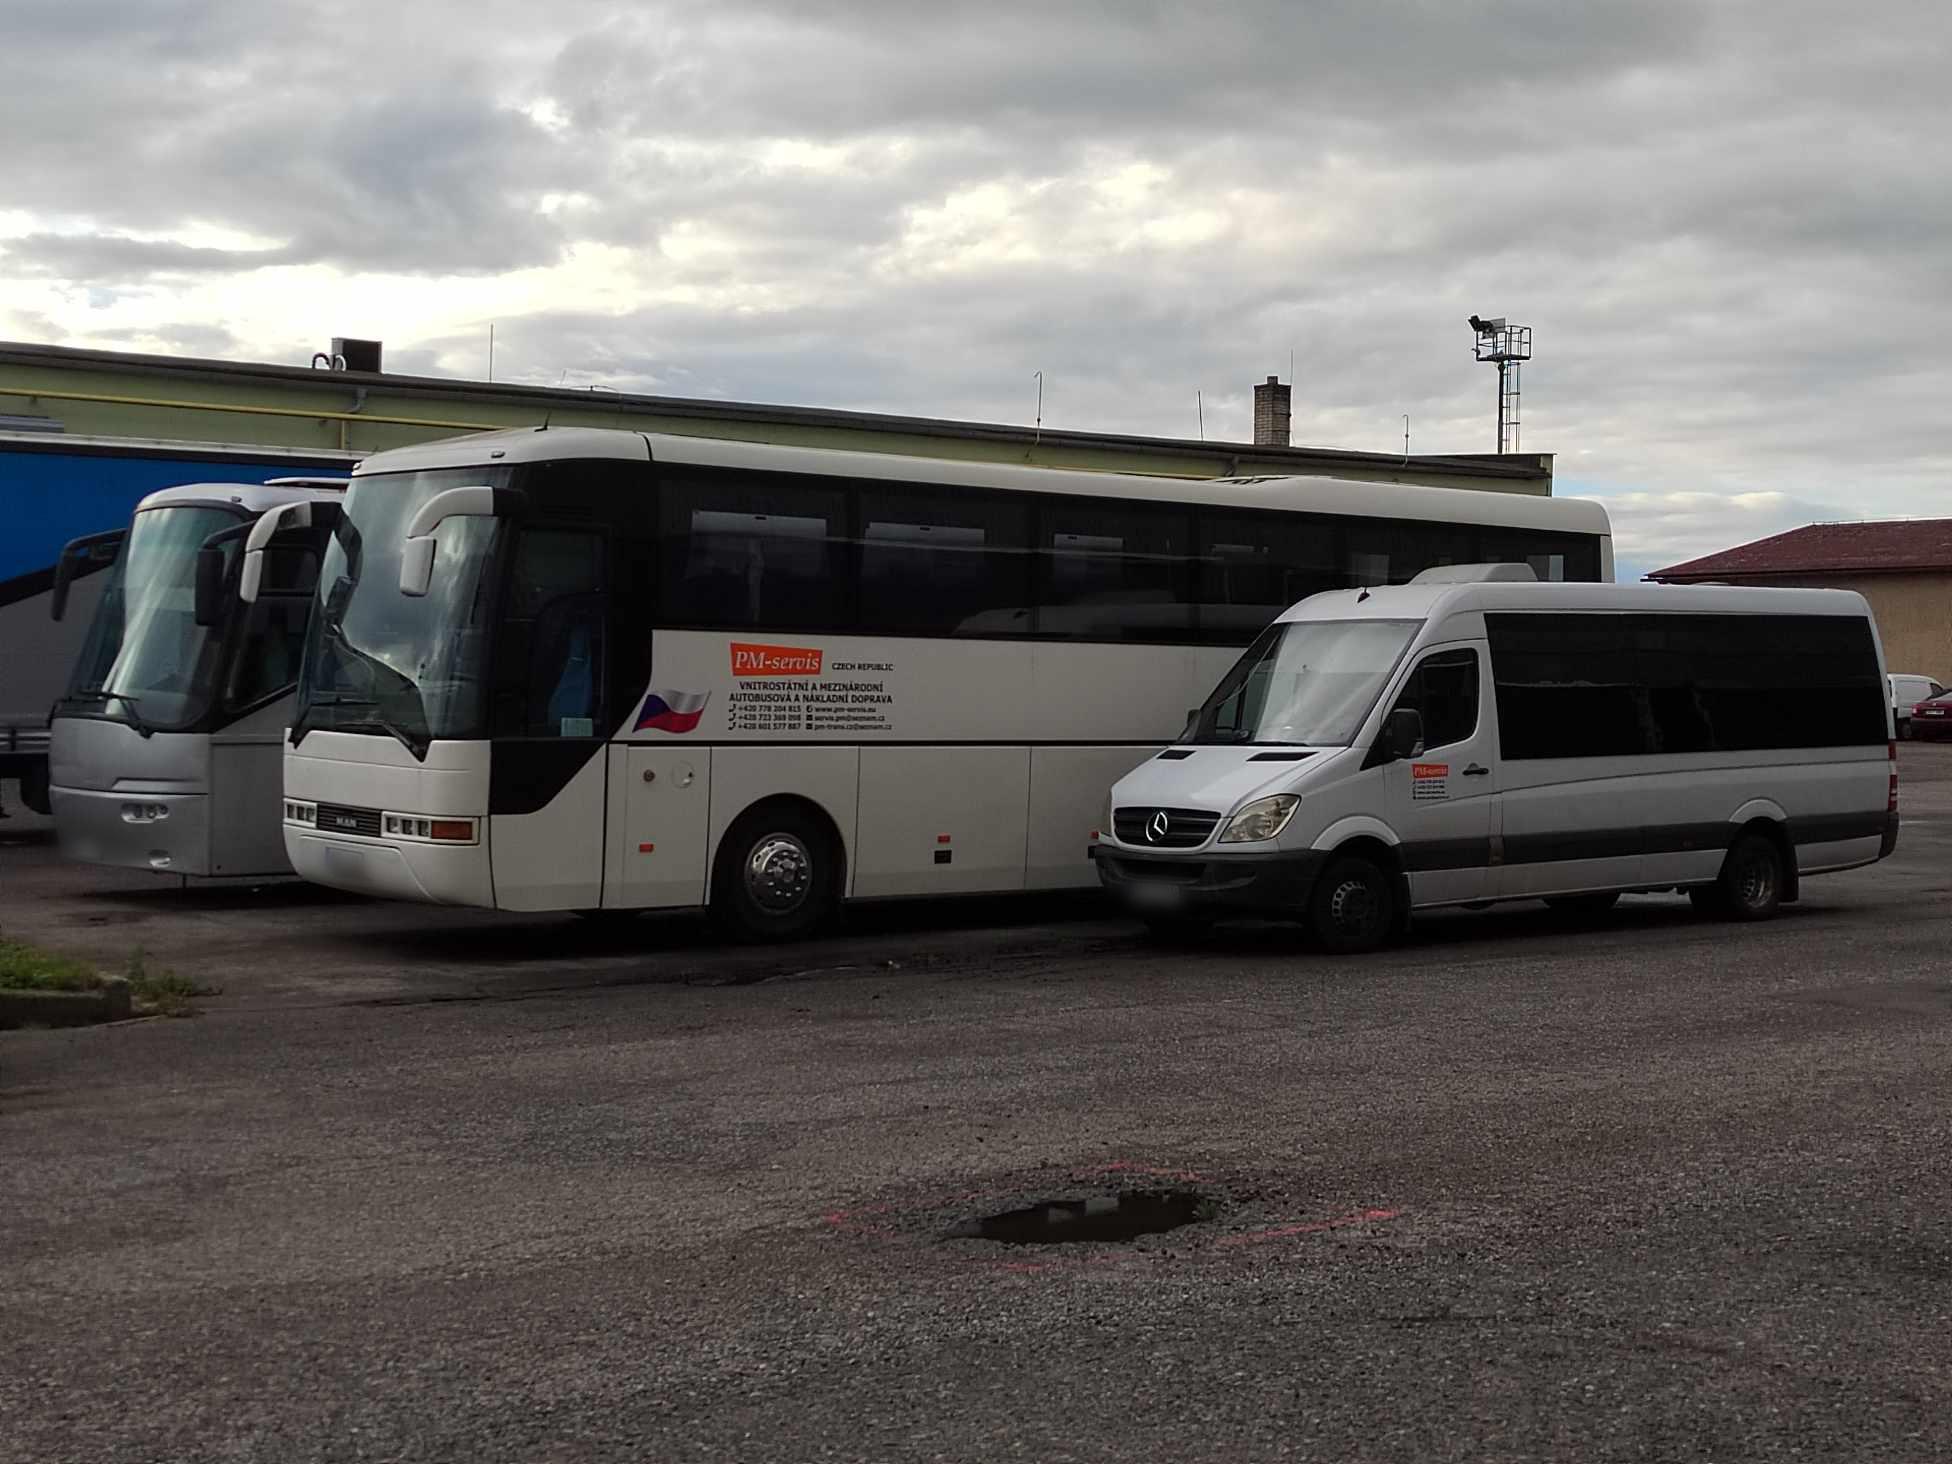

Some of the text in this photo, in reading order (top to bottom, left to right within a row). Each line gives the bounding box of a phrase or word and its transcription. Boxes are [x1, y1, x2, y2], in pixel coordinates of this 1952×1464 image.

[735, 651, 820, 670] PM-servis
[832, 662, 894, 671] CZECH REPUBLIC
[739, 681, 883, 692] VNITROSTÁTNÍ A MEZINÁRODNÍ
[729, 692, 893, 704] AUTOBUSOVÁ A NÁKLADNÍ DOPRAVA
